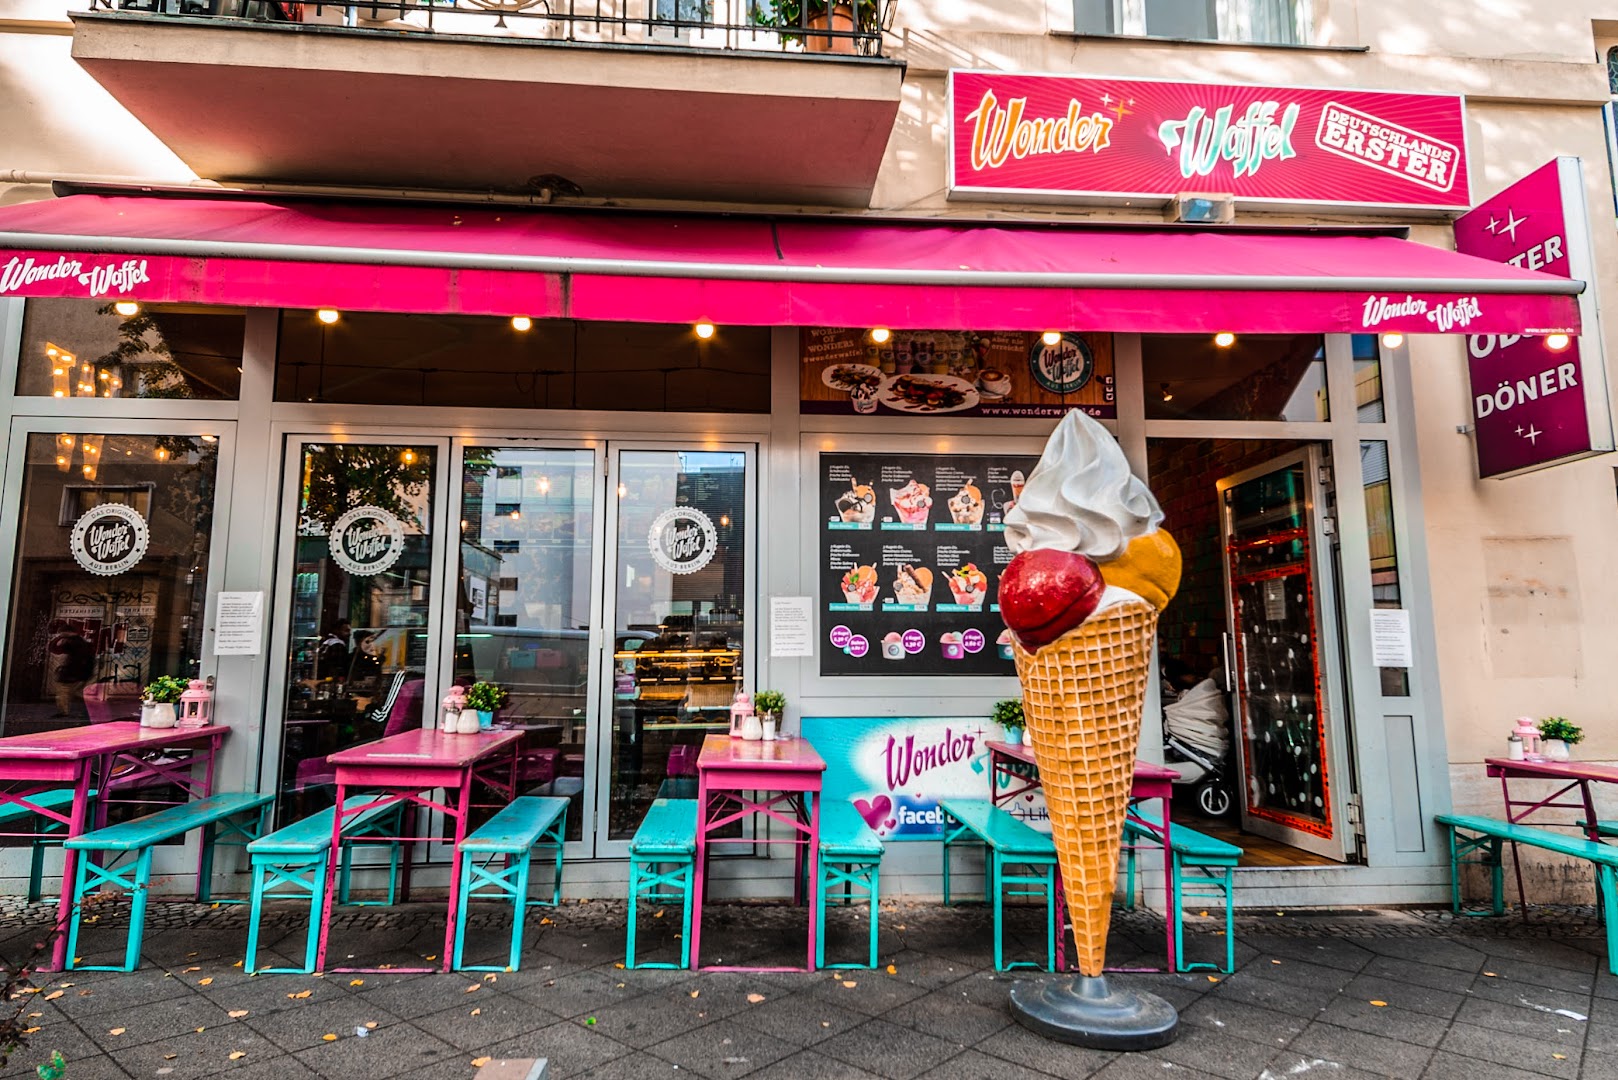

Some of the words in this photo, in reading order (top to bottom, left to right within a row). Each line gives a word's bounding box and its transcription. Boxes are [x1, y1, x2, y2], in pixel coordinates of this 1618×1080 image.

[964, 88, 1114, 171] Wonder
[1158, 101, 1300, 179] Waffel
[1327, 108, 1453, 163] DEUTSCHLANDS
[1321, 121, 1448, 186] ERSTER
[1504, 235, 1564, 271] TER
[0, 256, 82, 293] Wonder
[79, 259, 150, 297] Waffel
[1362, 295, 1428, 328] Wonder
[1427, 297, 1483, 332] Waffel
[1042, 347, 1077, 368] Wonder
[1475, 362, 1578, 419] DÖNER
[91, 509, 104, 519] DAS
[106, 508, 135, 521] ORIGINAL
[89, 523, 128, 546] Wonder
[91, 534, 130, 560] Waffel
[349, 536, 386, 561] Waffel
[89, 561, 102, 570] AUS
[105, 560, 129, 570] BERLIN
[347, 562, 360, 570] AUS
[880, 727, 976, 791] Wonder
[898, 805, 956, 825] faceb
[1029, 807, 1050, 821] Lik
